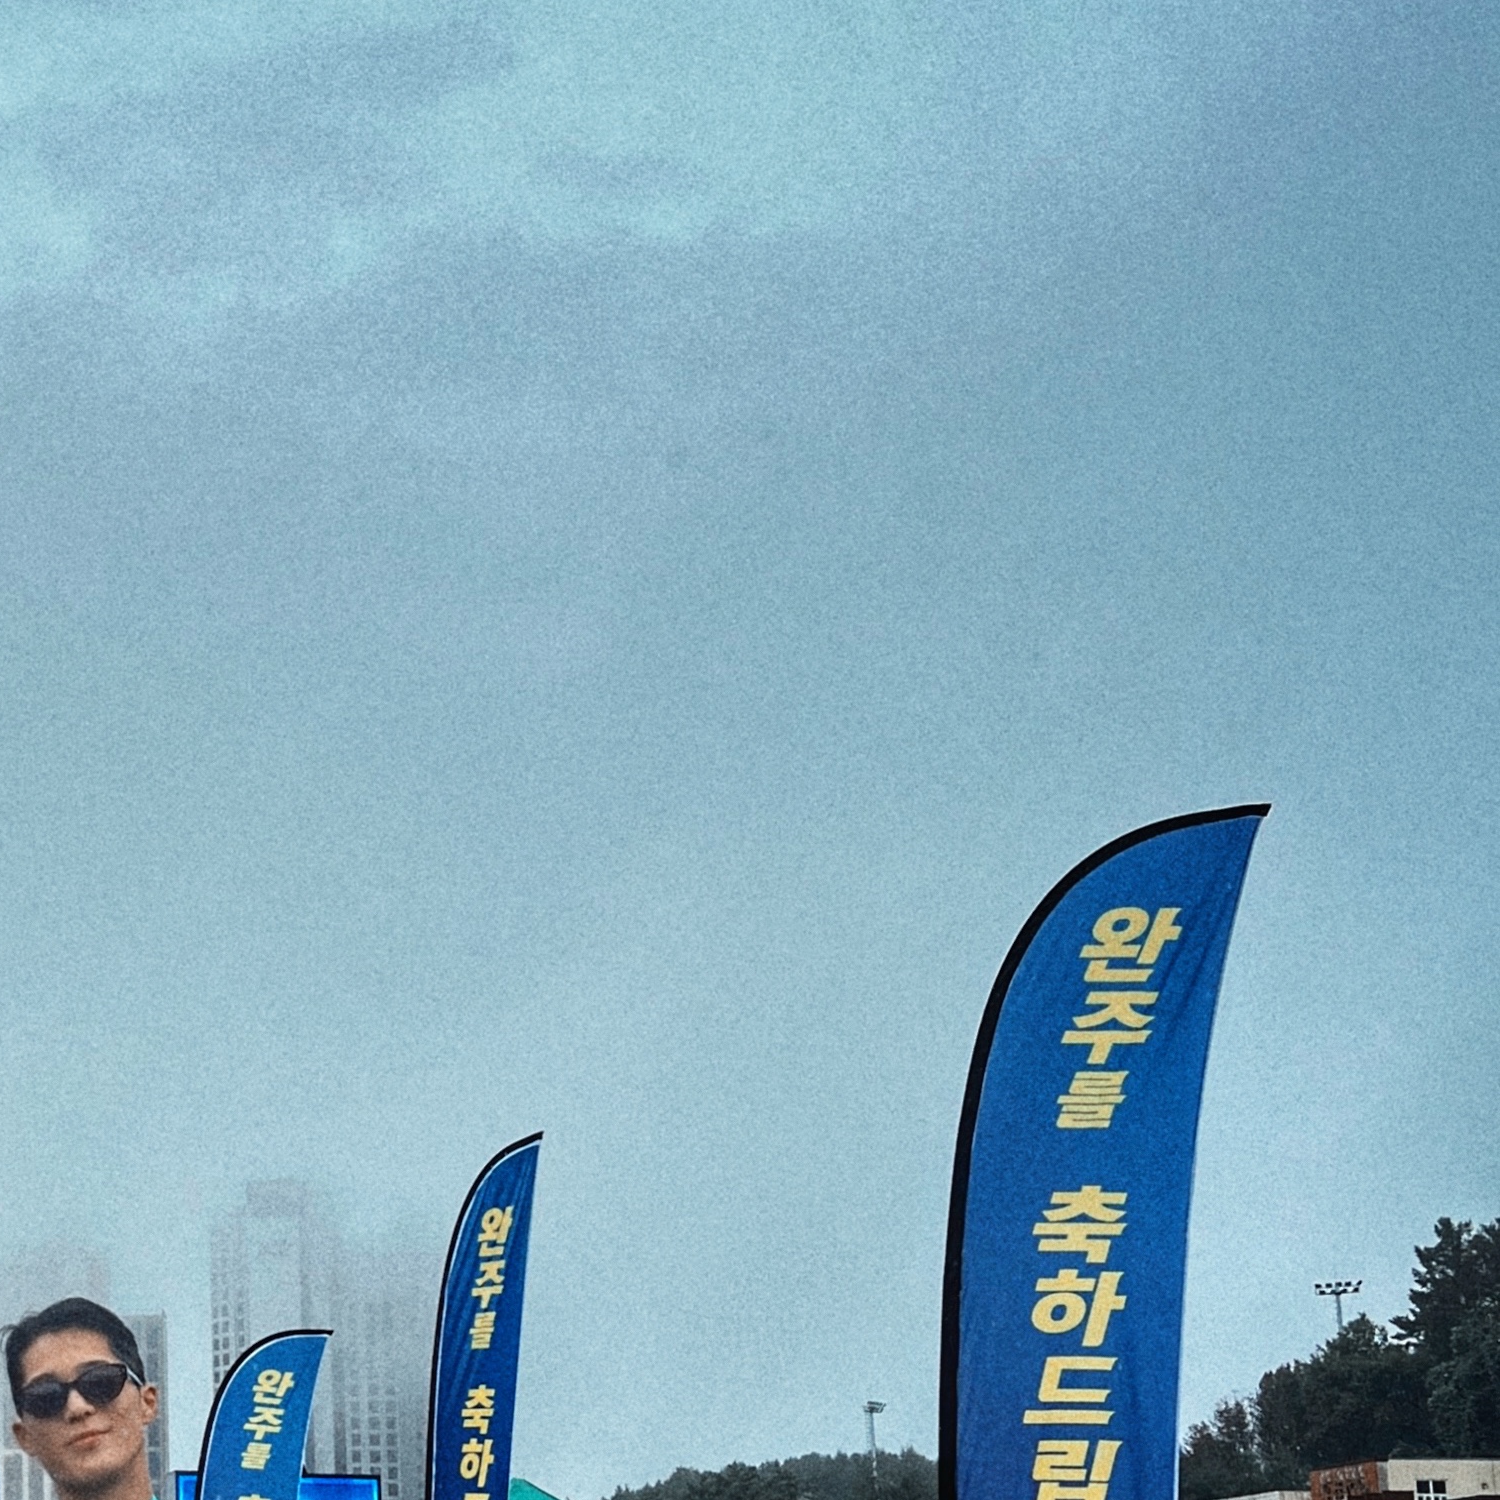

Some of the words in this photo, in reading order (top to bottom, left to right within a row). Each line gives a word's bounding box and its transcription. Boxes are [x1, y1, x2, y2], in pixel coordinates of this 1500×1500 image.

[1057, 906, 1181, 1129] 완주를
[469, 1206, 513, 1350] 완주를
[240, 1369, 294, 1470] 완주를
